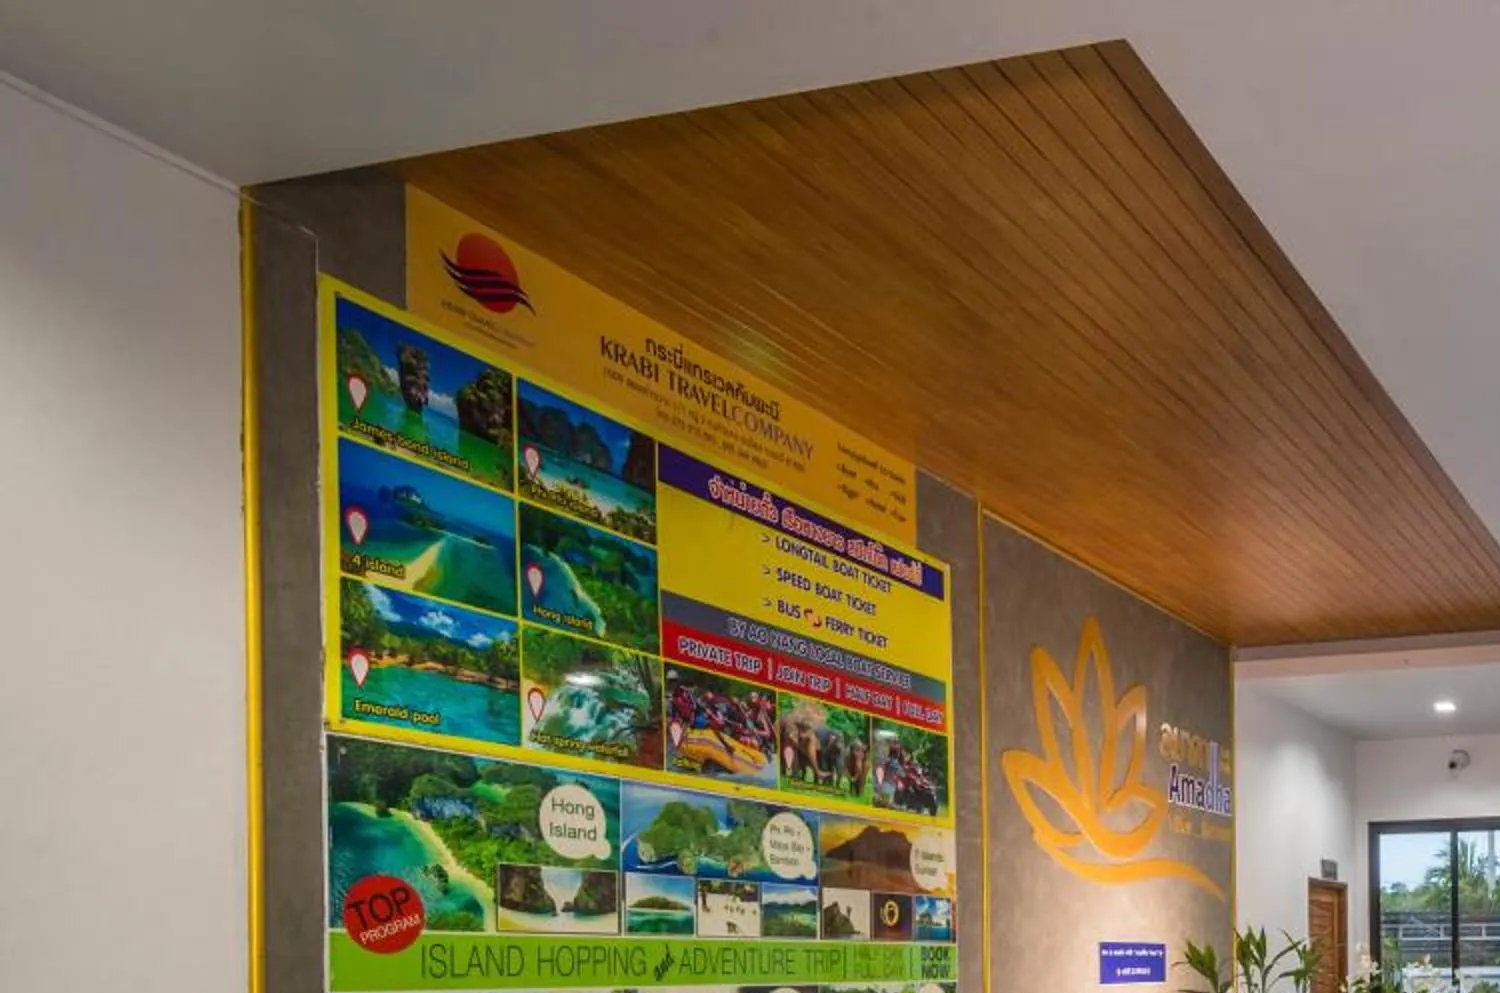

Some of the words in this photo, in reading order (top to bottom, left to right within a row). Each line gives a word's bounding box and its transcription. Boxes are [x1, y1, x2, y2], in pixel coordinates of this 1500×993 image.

[601, 335, 659, 383] KRABI
[352, 553, 362, 568] 4
[775, 536, 829, 569] LONGTAIL
[776, 566, 811, 593] SPEED
[815, 580, 844, 604] BOAT
[777, 598, 801, 620] BUS
[825, 614, 854, 637] FERRY
[677, 636, 732, 667] PRIVATE
[734, 649, 764, 674] TRIP
[355, 699, 409, 721] Emerald
[413, 709, 440, 726] pool
[551, 798, 596, 819] Hong
[549, 823, 597, 842] Island
[347, 887, 411, 930] TOP
[360, 913, 421, 945] PROGRAM
[421, 943, 525, 980] ISLAND
[536, 944, 648, 979] HOPPING
[678, 947, 795, 977] ADVENTURE
[803, 948, 842, 975] TRIP
